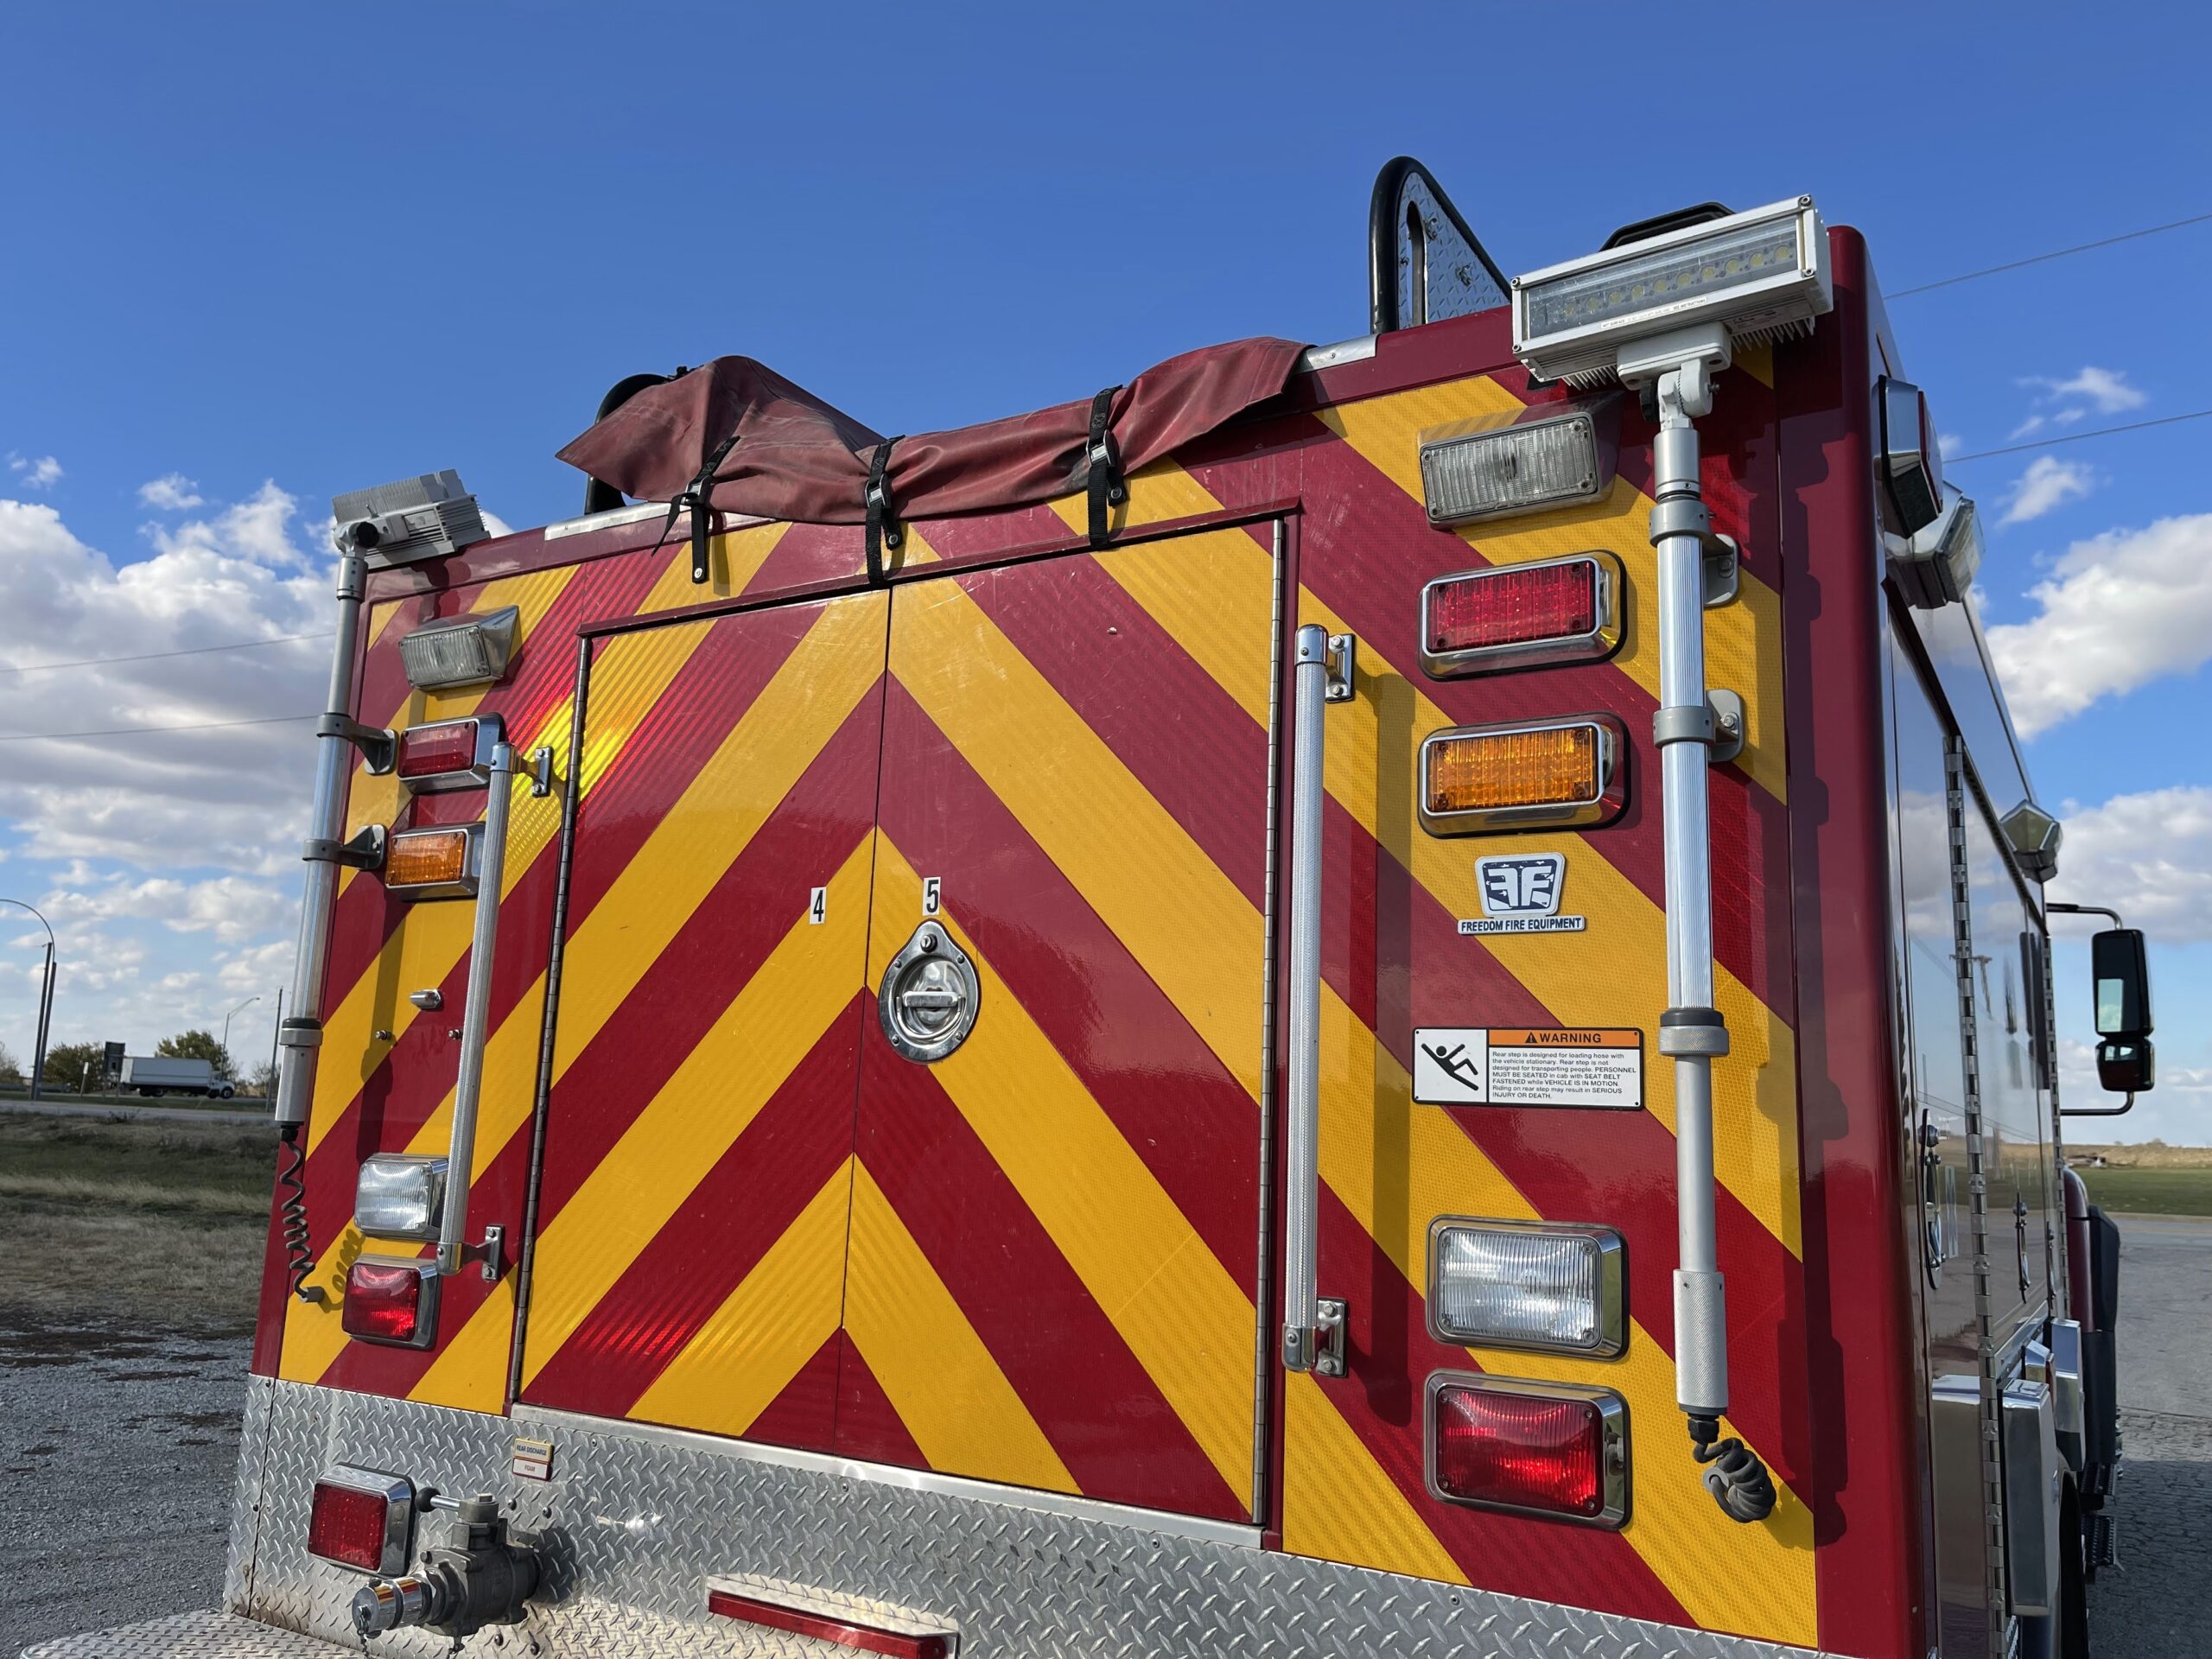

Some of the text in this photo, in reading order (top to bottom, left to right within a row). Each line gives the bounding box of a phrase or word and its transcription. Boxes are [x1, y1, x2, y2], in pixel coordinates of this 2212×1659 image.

[926, 879, 939, 913] 5
[813, 889, 824, 922] 4
[1461, 918, 1581, 932] FREEDOM FIRE EQUIPMENT
[1540, 1033, 1602, 1043] WARNING
[527, 1446, 546, 1455] DISCHARGE
